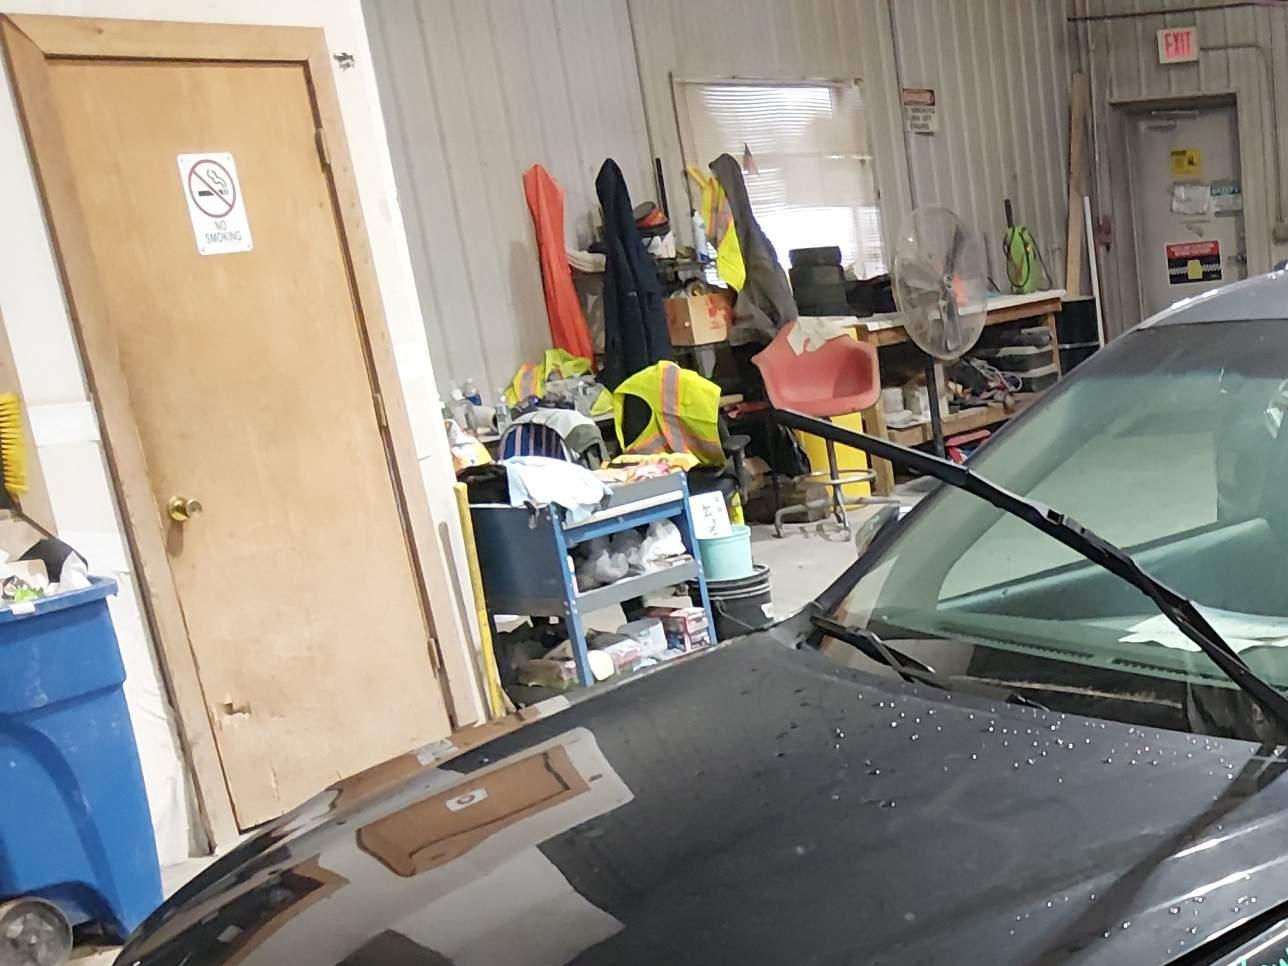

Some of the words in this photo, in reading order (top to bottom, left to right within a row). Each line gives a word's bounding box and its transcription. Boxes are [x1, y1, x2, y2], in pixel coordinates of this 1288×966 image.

[1164, 31, 1192, 57] EXIT
[214, 220, 228, 231] NO
[204, 230, 243, 243] SMOKING
